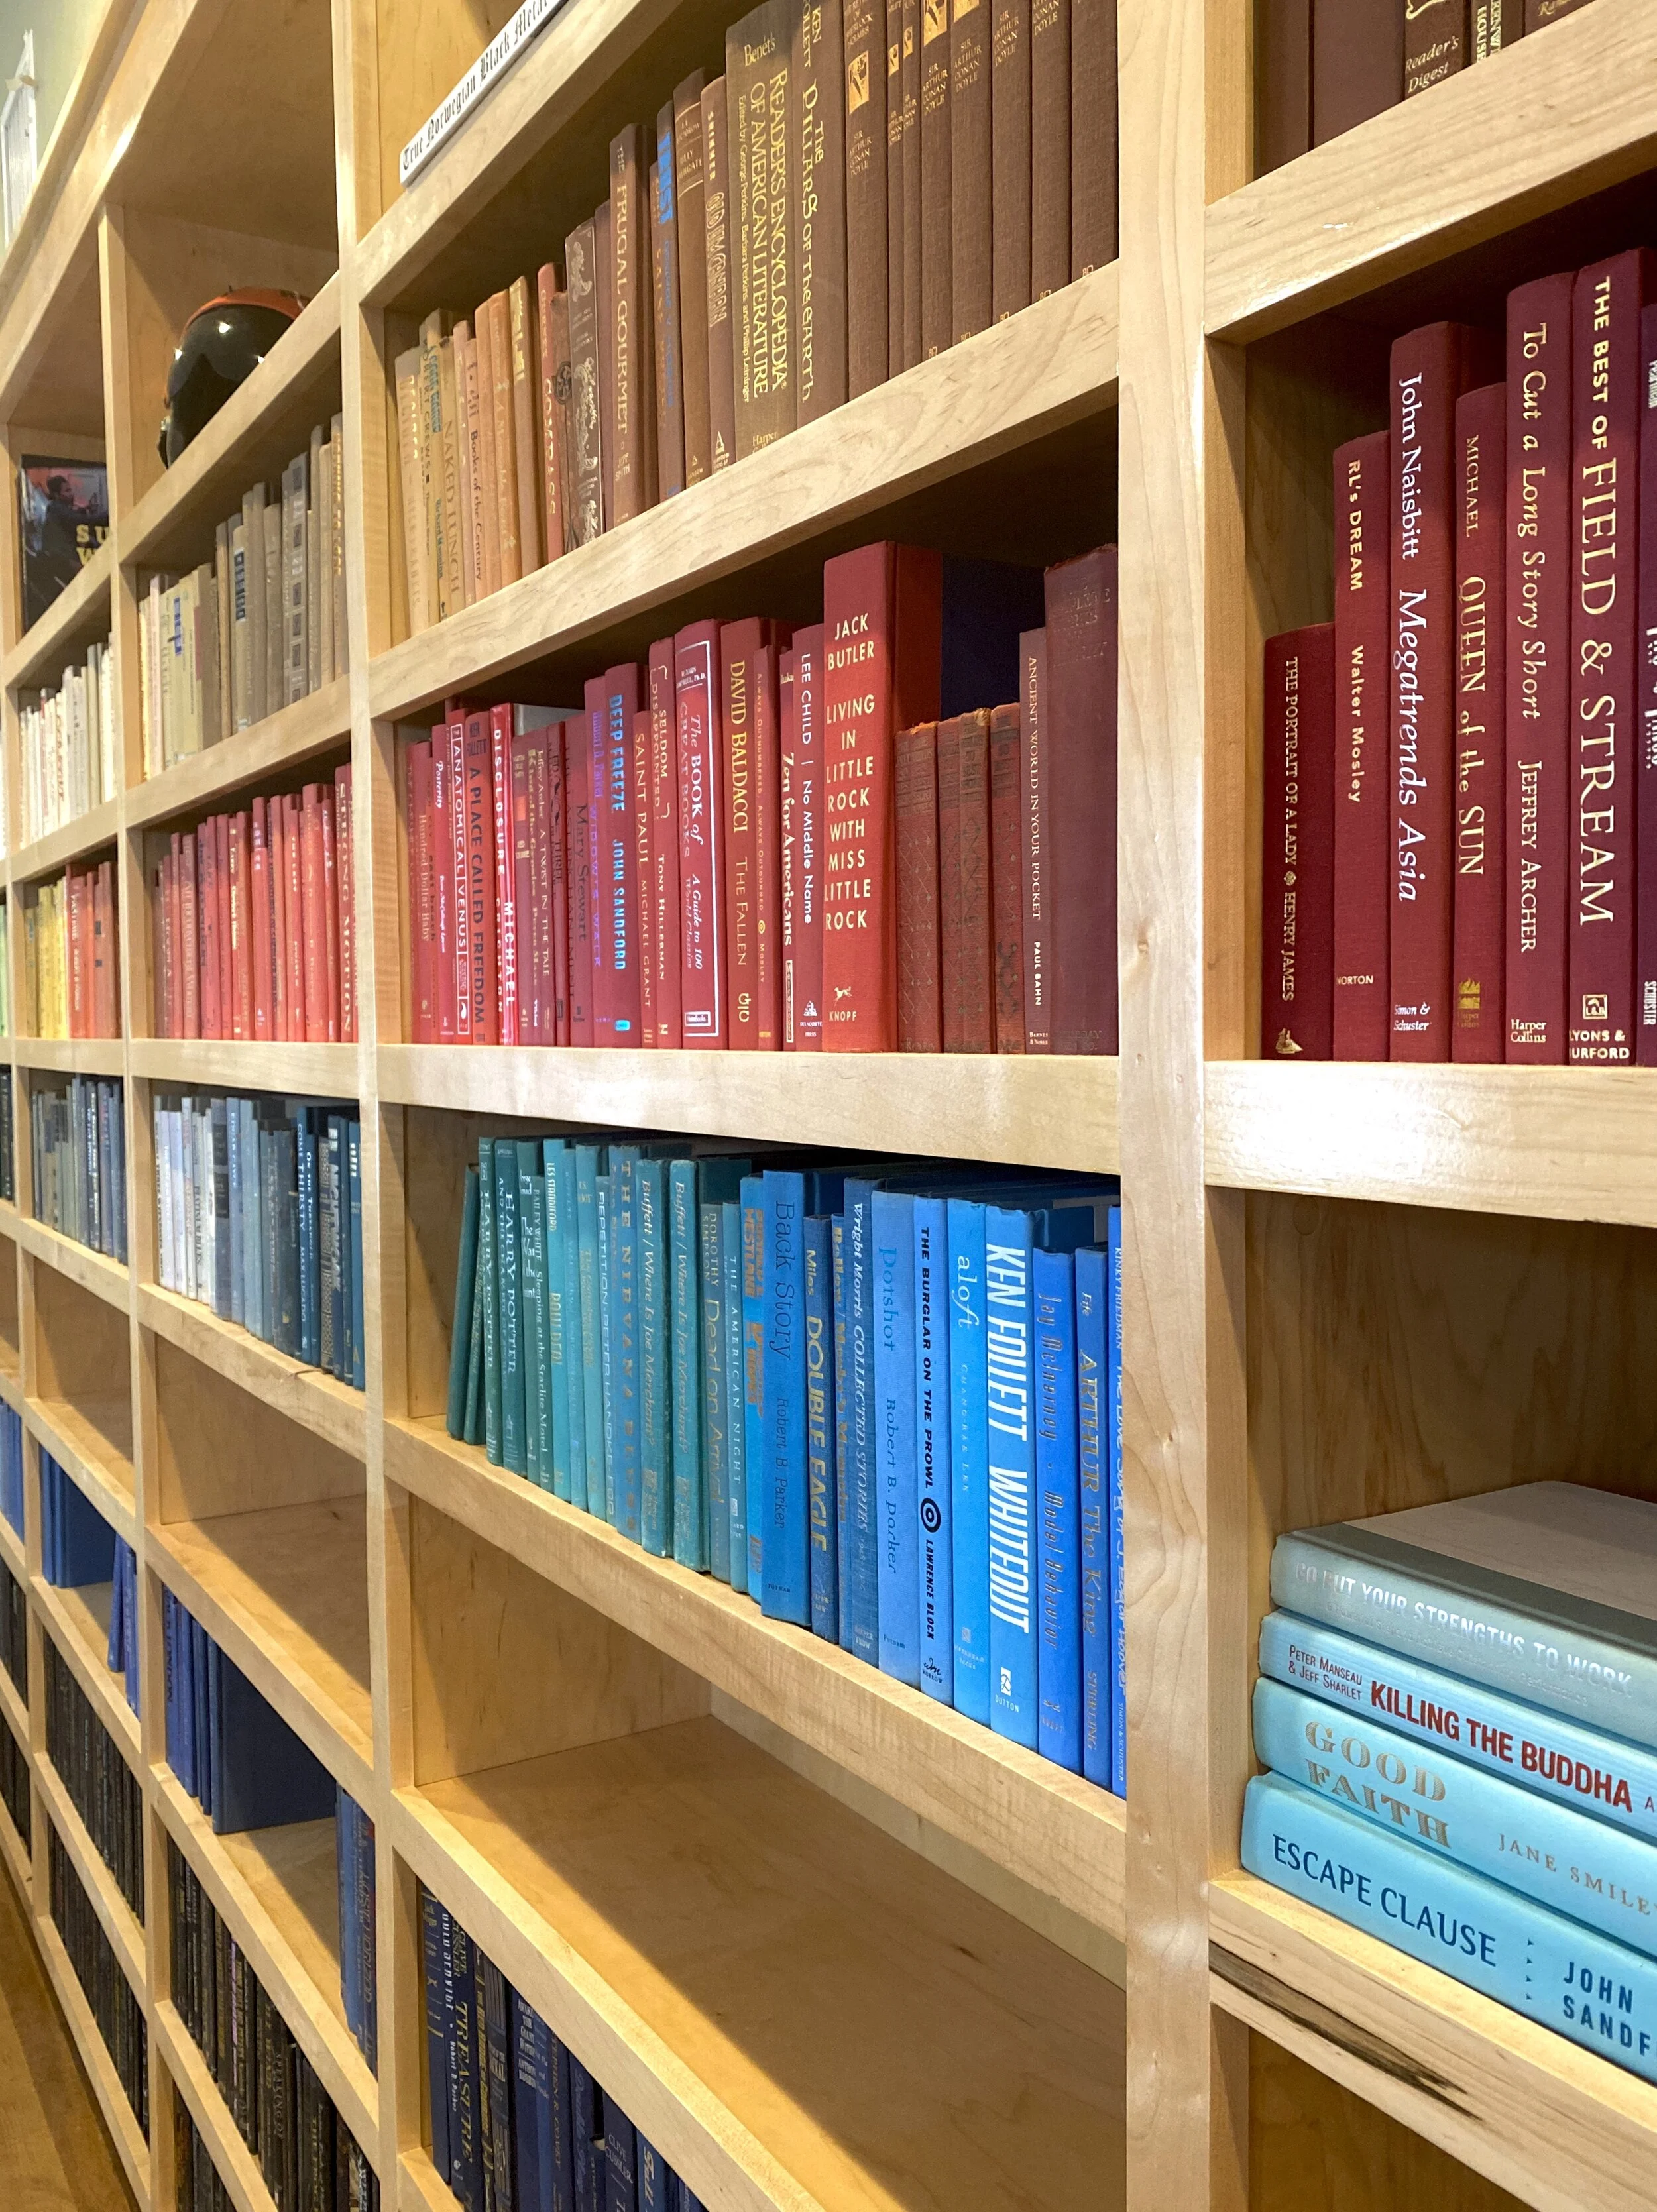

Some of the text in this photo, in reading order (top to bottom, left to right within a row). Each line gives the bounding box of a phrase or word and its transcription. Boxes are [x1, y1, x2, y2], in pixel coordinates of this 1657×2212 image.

[812, 5, 822, 43] KEN
[960, 38, 972, 52] SIR
[1000, 9, 1009, 23] SIR
[744, 32, 775, 67] Benét's
[1406, 35, 1459, 73] Reader's
[1408, 61, 1450, 93] Digest
[750, 82, 768, 398] OF AMERICAN LITERATURE
[616, 143, 628, 435] THE FRUGAL GOURMET
[470, 430, 479, 474] Books
[753, 431, 777, 447] Harper
[443, 420, 461, 594] NAKED LUNCH
[472, 478, 481, 492] of
[474, 522, 483, 582] Century
[834, 613, 869, 641] JACK
[1347, 460, 1365, 802] RL's DREAM Walter Mosley
[1579, 276, 1617, 926] THE BEST OF FIELD & STREAM
[828, 640, 874, 671] BUTLER
[1393, 372, 1427, 901] John Naisbitt Megatrends Asia
[1458, 435, 1486, 875] MICHAEL QUEEN of the SUN
[1516, 323, 1548, 953] To Cut a Long Story Short JEFFREY ARCHER
[827, 694, 875, 724] LIVING
[842, 729, 856, 750] IN
[470, 767, 481, 781] A
[635, 733, 646, 802] SAINT
[659, 709, 667, 779] SELDOM
[782, 752, 795, 792] Zen
[827, 755, 874, 784] LITTLE
[690, 715, 704, 845] The BOOK of
[730, 660, 749, 966] DAVID BALDACCI THE FALLEN
[801, 653, 814, 924] LEE CHILD No Middle Name
[828, 787, 870, 813] ROCK
[453, 745, 467, 948] ANATOMICAL VENUS
[471, 787, 482, 847] PLACE
[637, 812, 648, 869] PAUL
[782, 797, 795, 830] for
[830, 818, 865, 842] WITH
[1281, 657, 1298, 1001] THE PORTRAIT OF A LADY HENRY JAMES
[471, 854, 483, 924] CALLED
[494, 730, 515, 1007] DISCLOSURE MICHAEL
[782, 832, 795, 946] Americans
[824, 879, 872, 902] LITTLE
[828, 849, 866, 872] MISS
[340, 782, 351, 1033] STRONG MOTION
[640, 879, 649, 950] MICHAEL
[691, 873, 703, 970] A Guide to 100
[826, 909, 868, 931] ROCK
[474, 932, 485, 1024] FREEDOM
[1394, 1001, 1431, 1017] Simon &
[828, 1011, 858, 1022] KNOPF
[1394, 1019, 1430, 1032] Schuster
[1511, 1019, 1547, 1032] Harper
[1511, 1031, 1546, 1044] Collins
[504, 1192, 516, 1374] HARRY POTTER
[709, 1212, 720, 1288] DOROTHY
[731, 1306, 740, 1409] AMERICAN
[851, 1202, 868, 1533] Wright Morris COLLECTED STORIES
[805, 1248, 827, 1551] Miles DOUBLE EAGLE
[733, 1422, 742, 1485] NIGHT
[921, 1227, 935, 1641] THE BURGLAR ON THE PROWL LAWRENCE BLOCK
[986, 1243, 1029, 1635] KEN FOLLETT WHITEOUT
[1079, 1292, 1102, 1637] Fife ARTHUR The King
[1288, 1644, 1363, 1687] PETER MANSEAU
[1288, 1661, 1362, 1702] & JEFF SHARLET
[995, 1694, 1019, 1713] DUTTON
[1304, 1721, 1447, 1802] GOOD
[1370, 1681, 1655, 1814] KILLING THE BUDDHA A
[1304, 1757, 1453, 1850] FAITH
[1272, 1834, 1497, 1967] ESCAPE CLAUSE
[1564, 1961, 1634, 2014] JOHN
[455, 2001, 473, 2164] TREASURE
